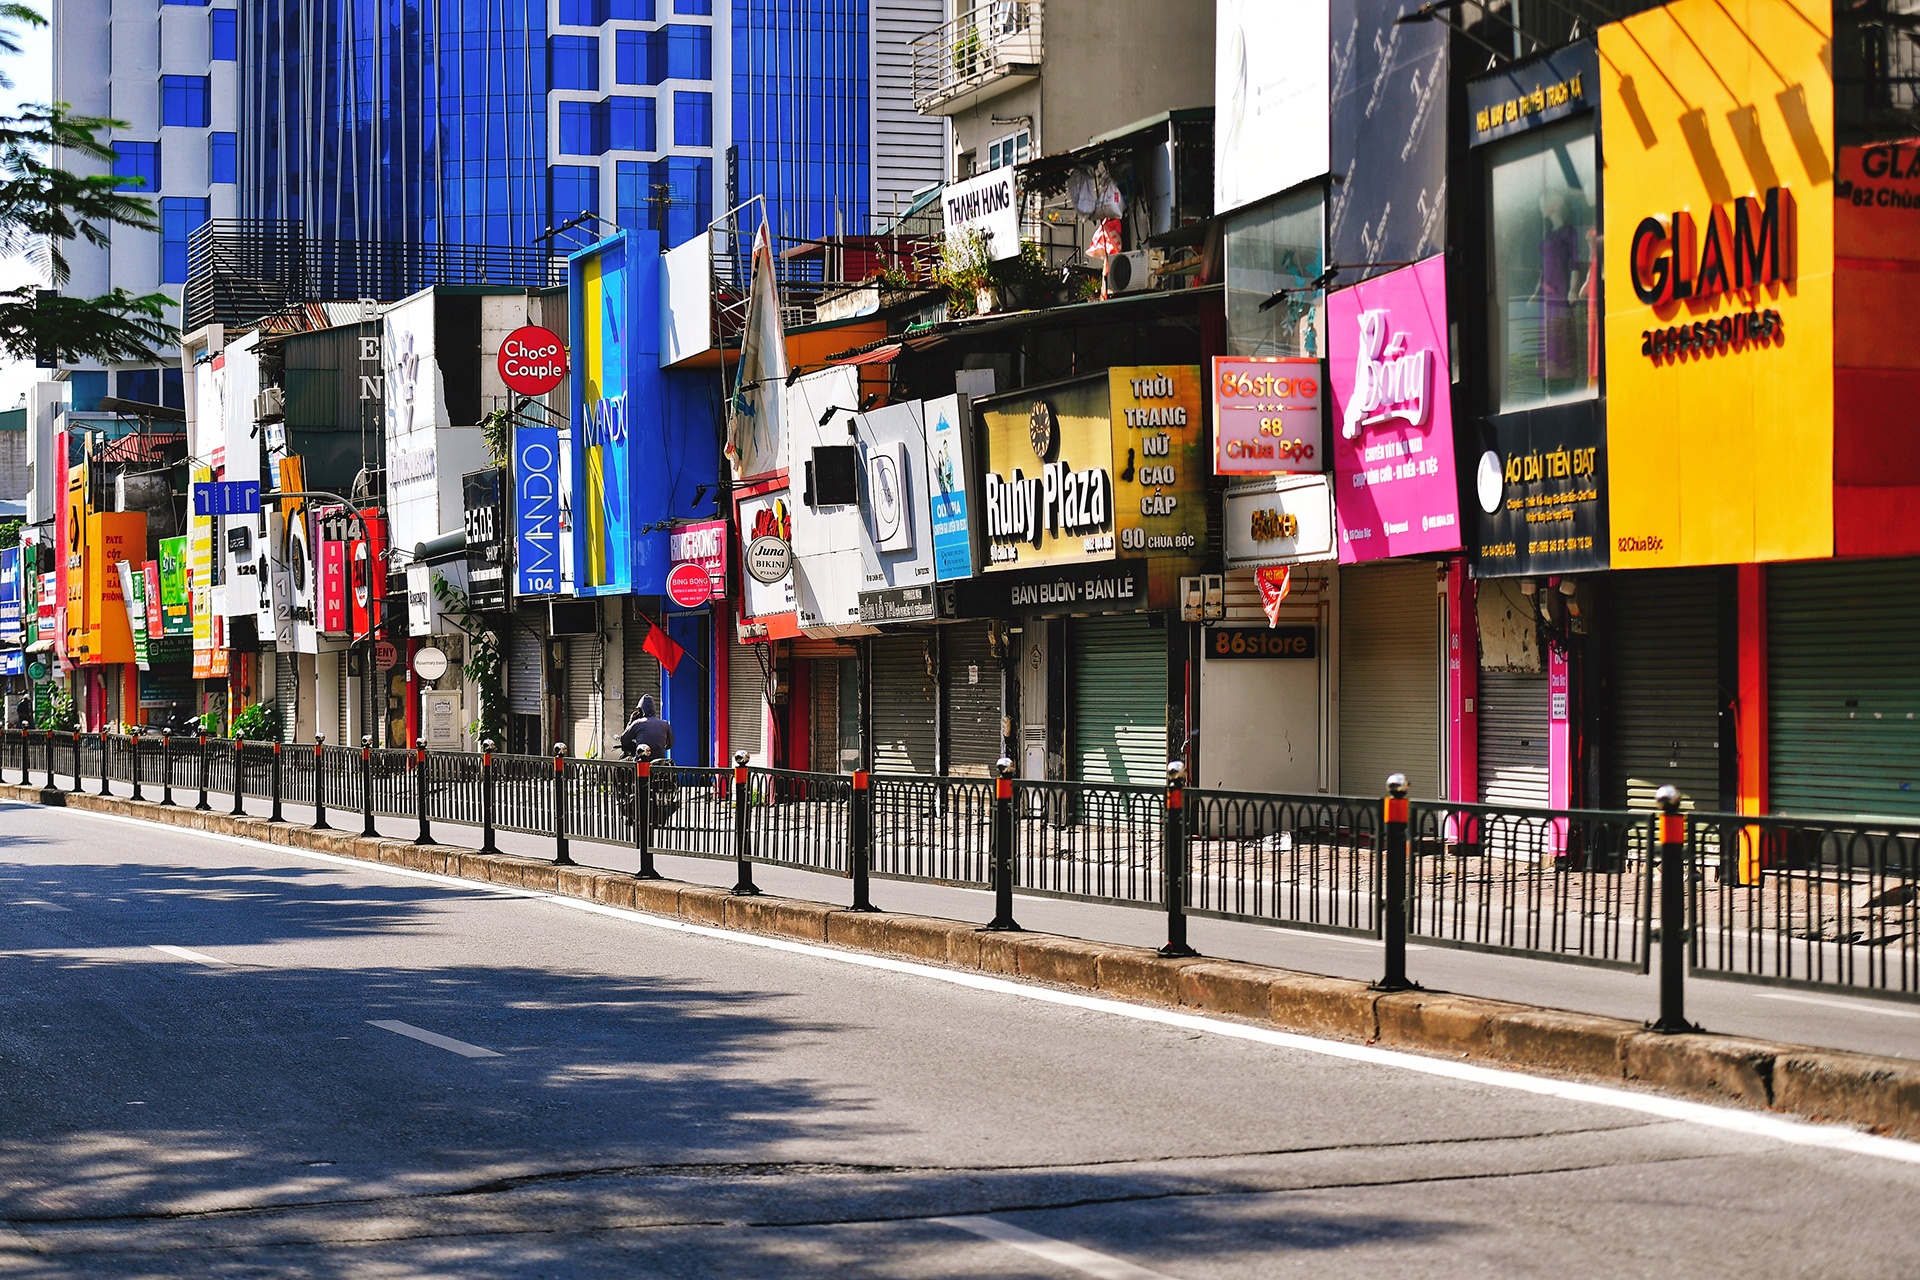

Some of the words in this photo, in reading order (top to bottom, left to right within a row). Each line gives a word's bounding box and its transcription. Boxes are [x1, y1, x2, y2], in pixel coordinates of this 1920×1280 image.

[948, 190, 980, 226] THANH
[982, 180, 1010, 216] HANG
[1630, 186, 1783, 306] GLAM
[504, 340, 557, 360] Choco
[504, 359, 562, 380] Couple
[1221, 371, 1318, 398] 86store
[1124, 406, 1187, 427] TRANG
[1260, 417, 1283, 437] 88
[1226, 438, 1274, 459] Chùa
[1279, 438, 1314, 464] Bộc
[1140, 466, 1175, 486] CAO
[1504, 452, 1521, 483] ÁO
[1524, 448, 1542, 481] DÀI
[1573, 447, 1596, 480] ĐẠT
[522, 444, 554, 573] MANDO
[986, 469, 1036, 541] Ruby
[1043, 461, 1105, 530] Plaza
[1141, 488, 1177, 516] CẤP
[325, 518, 362, 540] 114
[1121, 528, 1145, 549] 90
[1148, 534, 1173, 548] CHÙA
[1175, 532, 1195, 550] BỘC
[106, 548, 121, 560] CỘT
[755, 546, 785, 556] Juna
[1647, 536, 1663, 554] Bộc
[756, 560, 785, 568] BIKINI
[328, 545, 340, 628] IKINI
[528, 578, 554, 591] 104
[1011, 581, 1038, 605] BÁN
[1040, 577, 1076, 602] BUÔN
[1085, 575, 1114, 600] BÁN
[276, 579, 291, 644] 124
[376, 648, 394, 657] ENY
[1216, 632, 1307, 654] 86store
